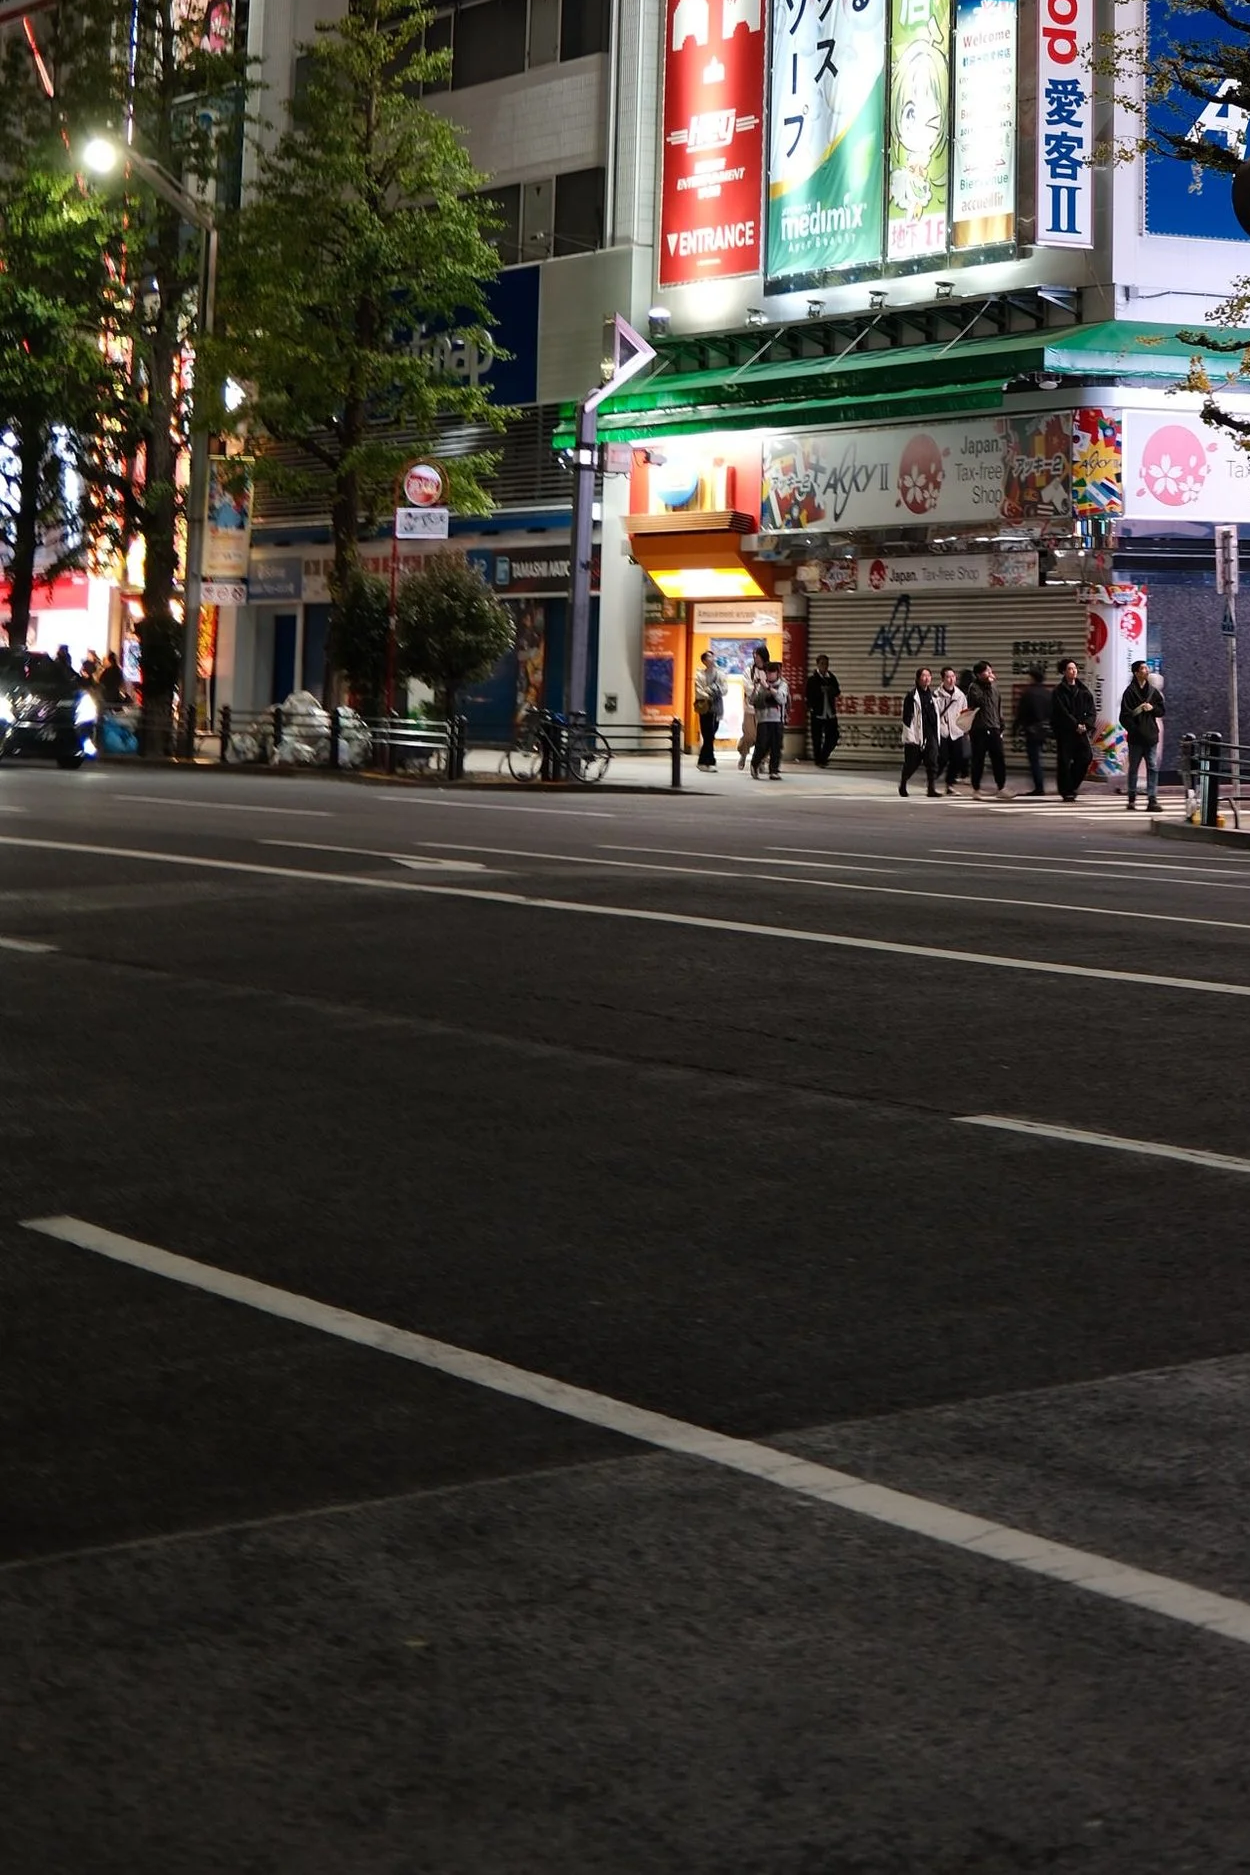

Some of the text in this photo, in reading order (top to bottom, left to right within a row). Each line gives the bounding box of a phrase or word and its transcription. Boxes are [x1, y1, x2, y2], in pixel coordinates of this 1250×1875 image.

[962, 28, 1012, 49] Welcome
[781, 193, 864, 242] medimix
[680, 220, 755, 257] ENTRANCE
[960, 435, 1002, 457] Japan.
[955, 462, 1002, 482] Tax-free
[1013, 455, 1063, 477] アッキー2
[972, 486, 1002, 509] Shop
